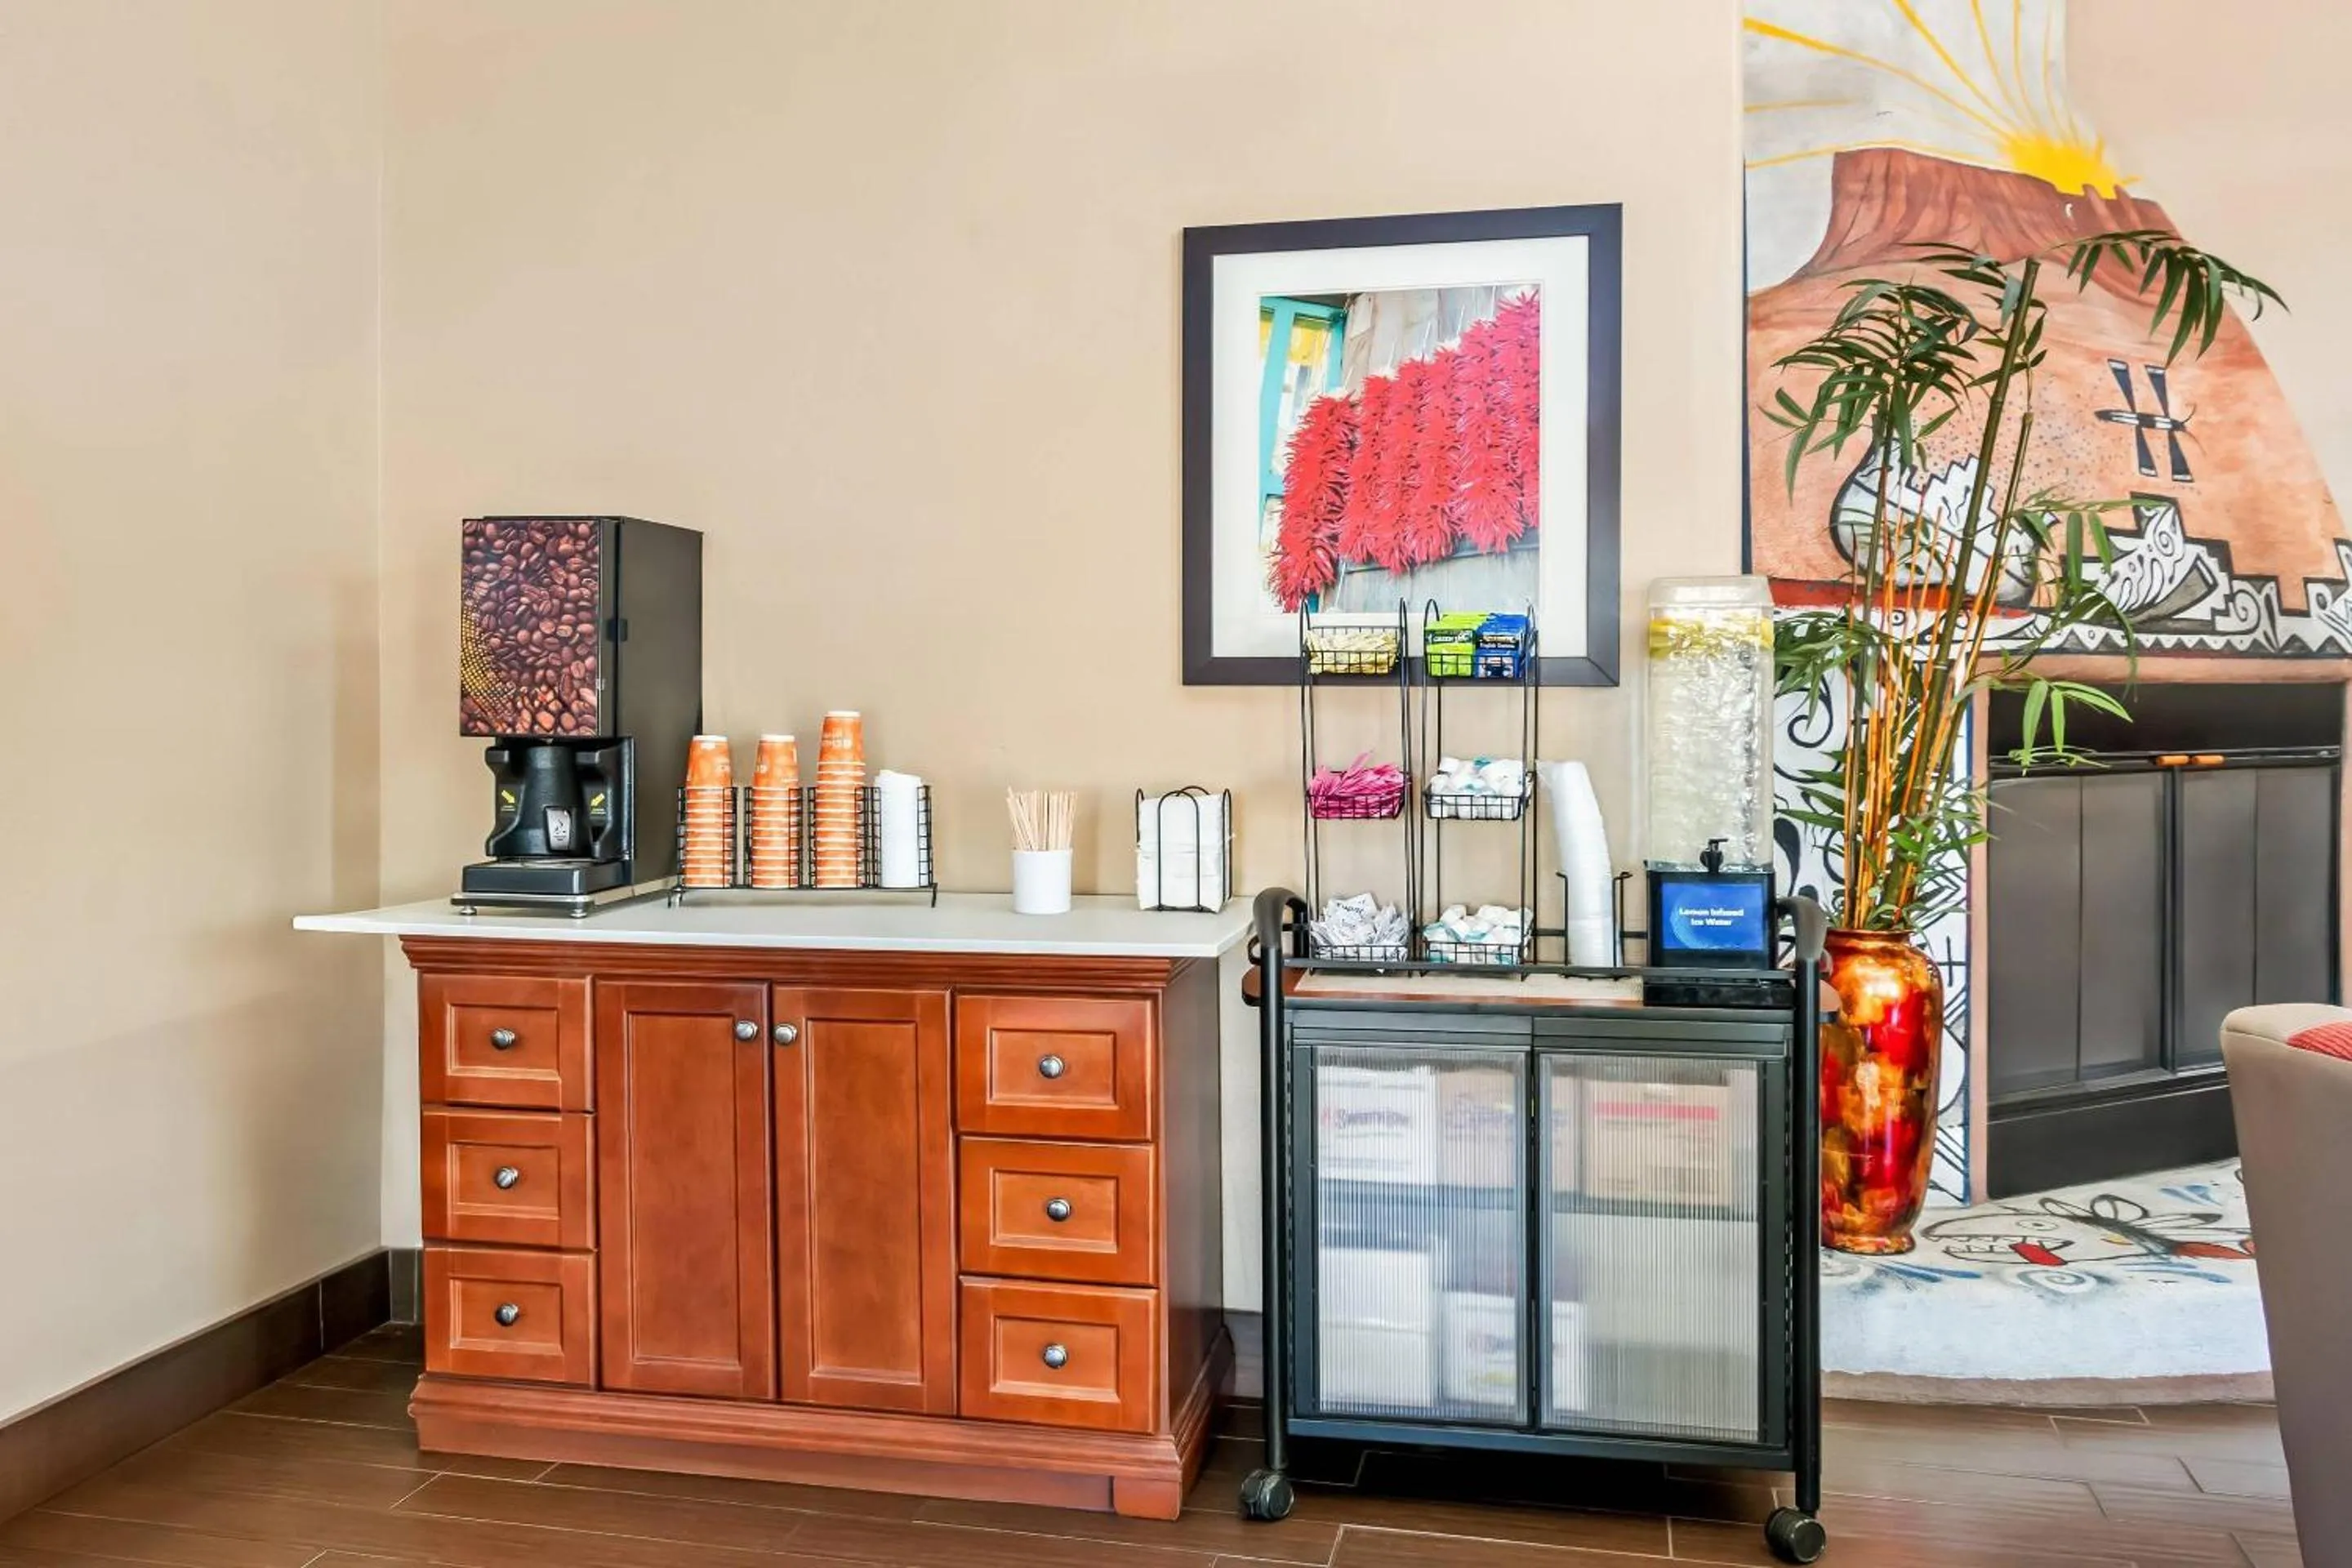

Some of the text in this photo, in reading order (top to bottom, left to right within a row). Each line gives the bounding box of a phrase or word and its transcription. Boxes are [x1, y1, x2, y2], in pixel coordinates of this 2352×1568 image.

[1678, 907, 1744, 916] Lemon Infused
[1690, 917, 1732, 925] Ice Water
